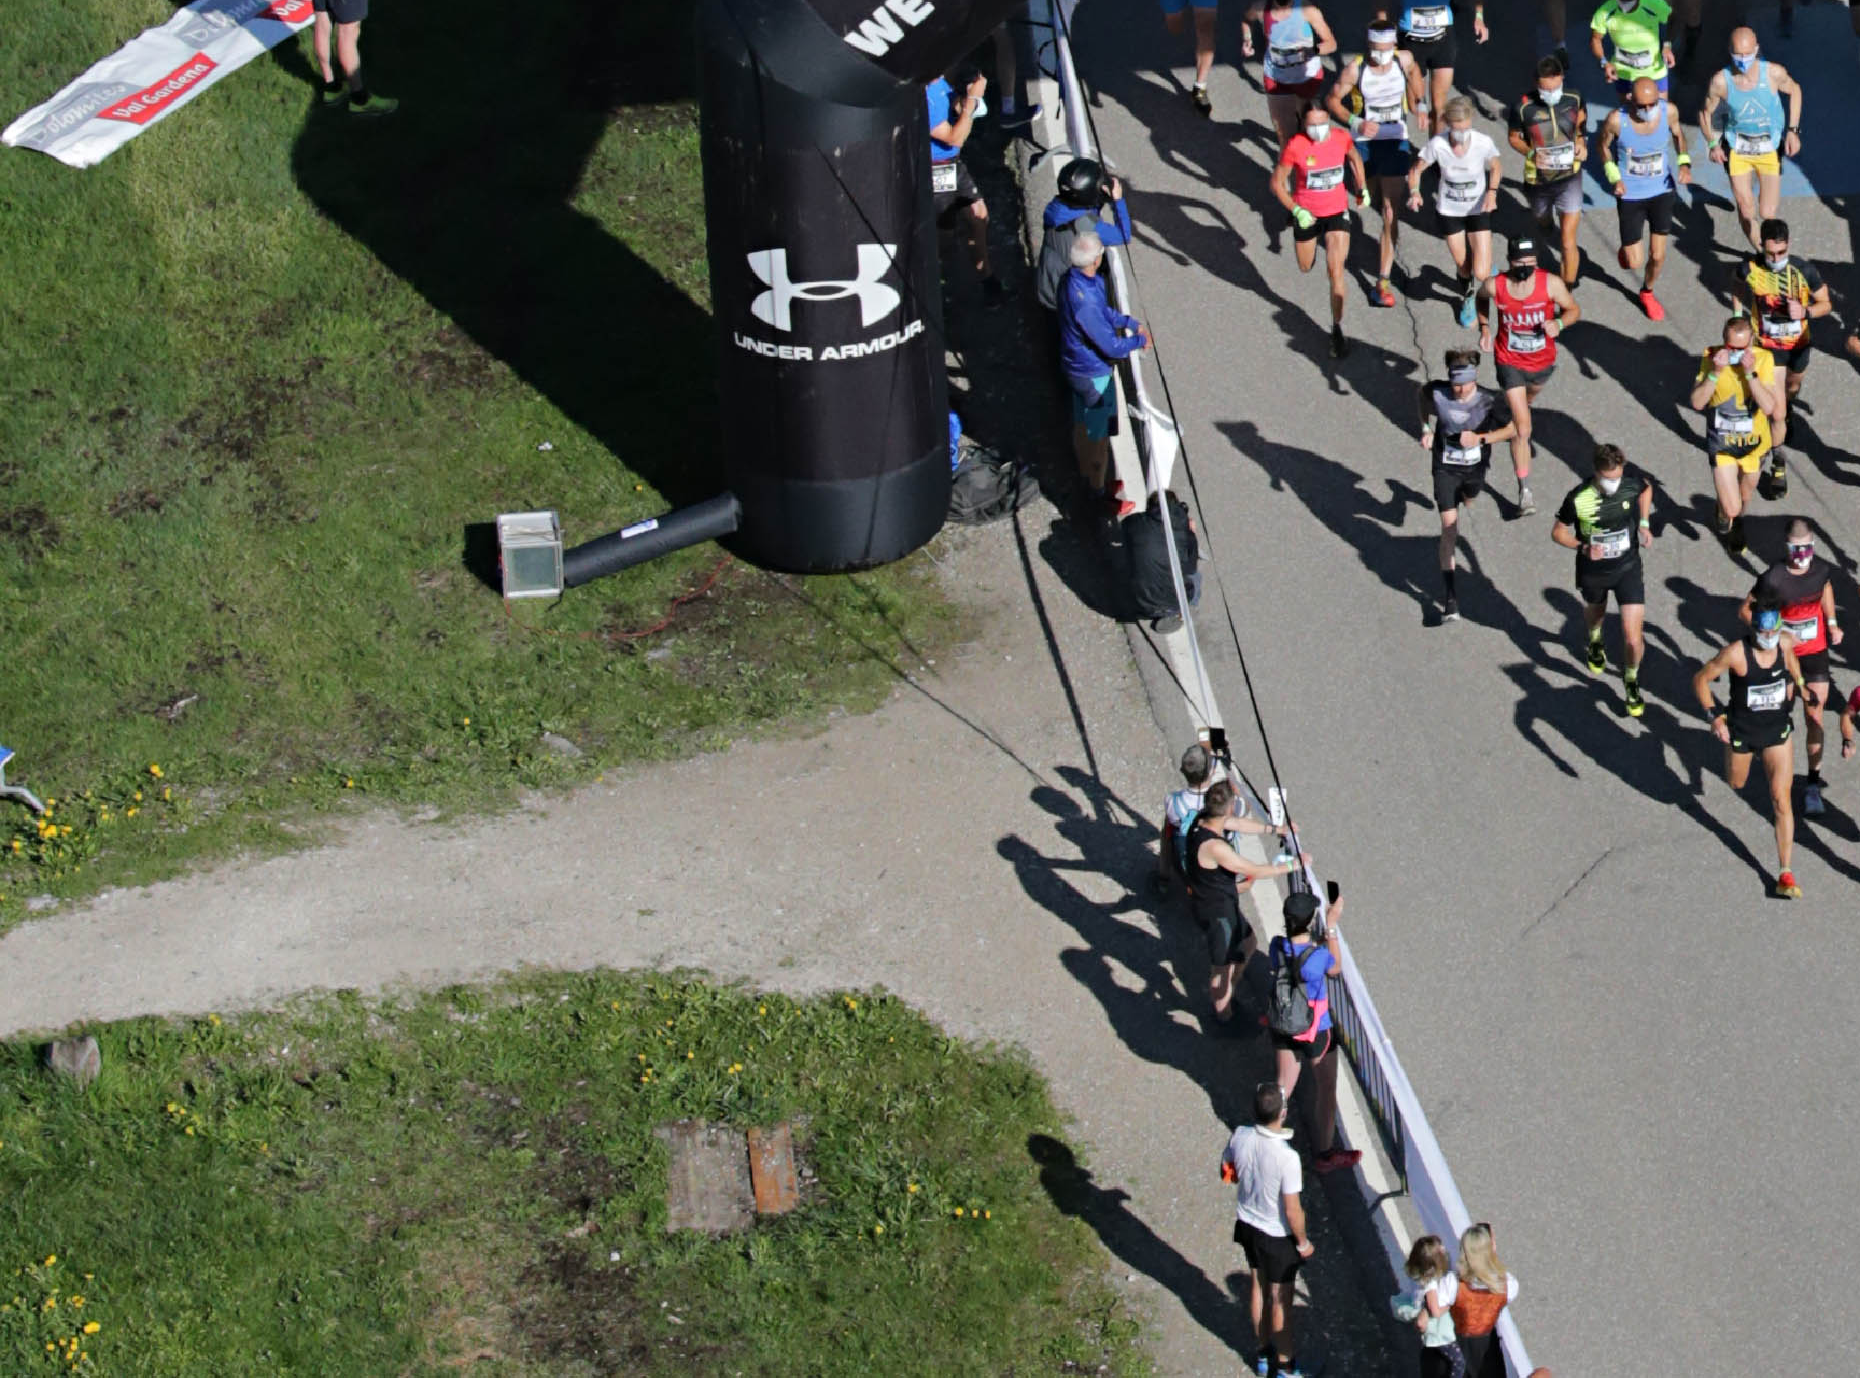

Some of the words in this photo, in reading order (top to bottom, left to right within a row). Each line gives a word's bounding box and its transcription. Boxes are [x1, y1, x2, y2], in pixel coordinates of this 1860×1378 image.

[113, 99, 143, 123] Val
[141, 59, 208, 107] Gardena
[733, 331, 814, 361] UNDER
[819, 318, 924, 361] ARMOUR
